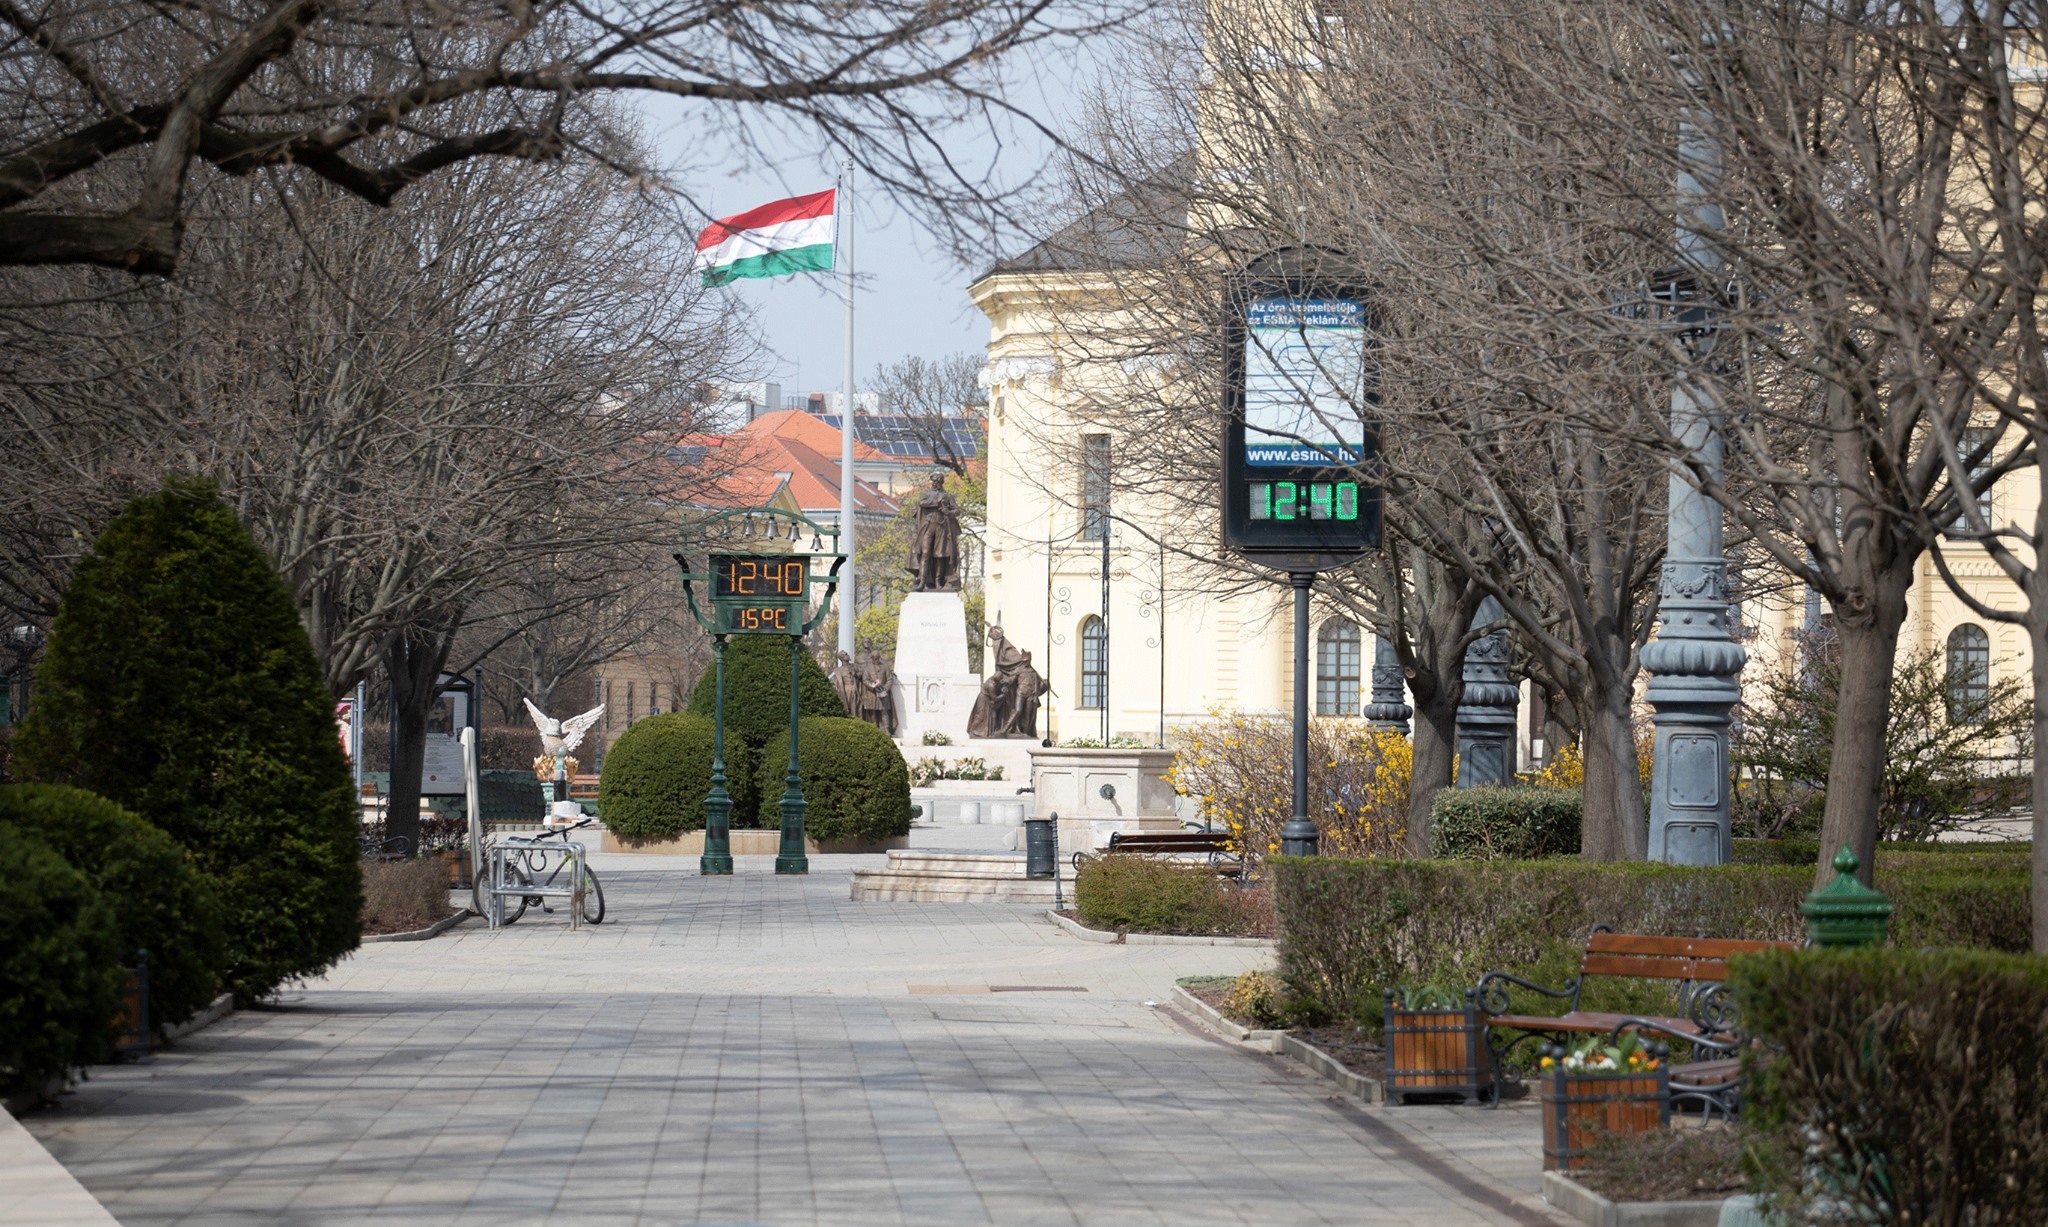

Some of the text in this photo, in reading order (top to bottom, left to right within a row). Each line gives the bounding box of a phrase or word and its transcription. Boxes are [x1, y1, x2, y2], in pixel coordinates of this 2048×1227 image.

[1251, 303, 1266, 313] Az
[1263, 315, 1295, 325] ESMA
[1299, 315, 1338, 325] eklám
[1265, 481, 1358, 520] 12:40
